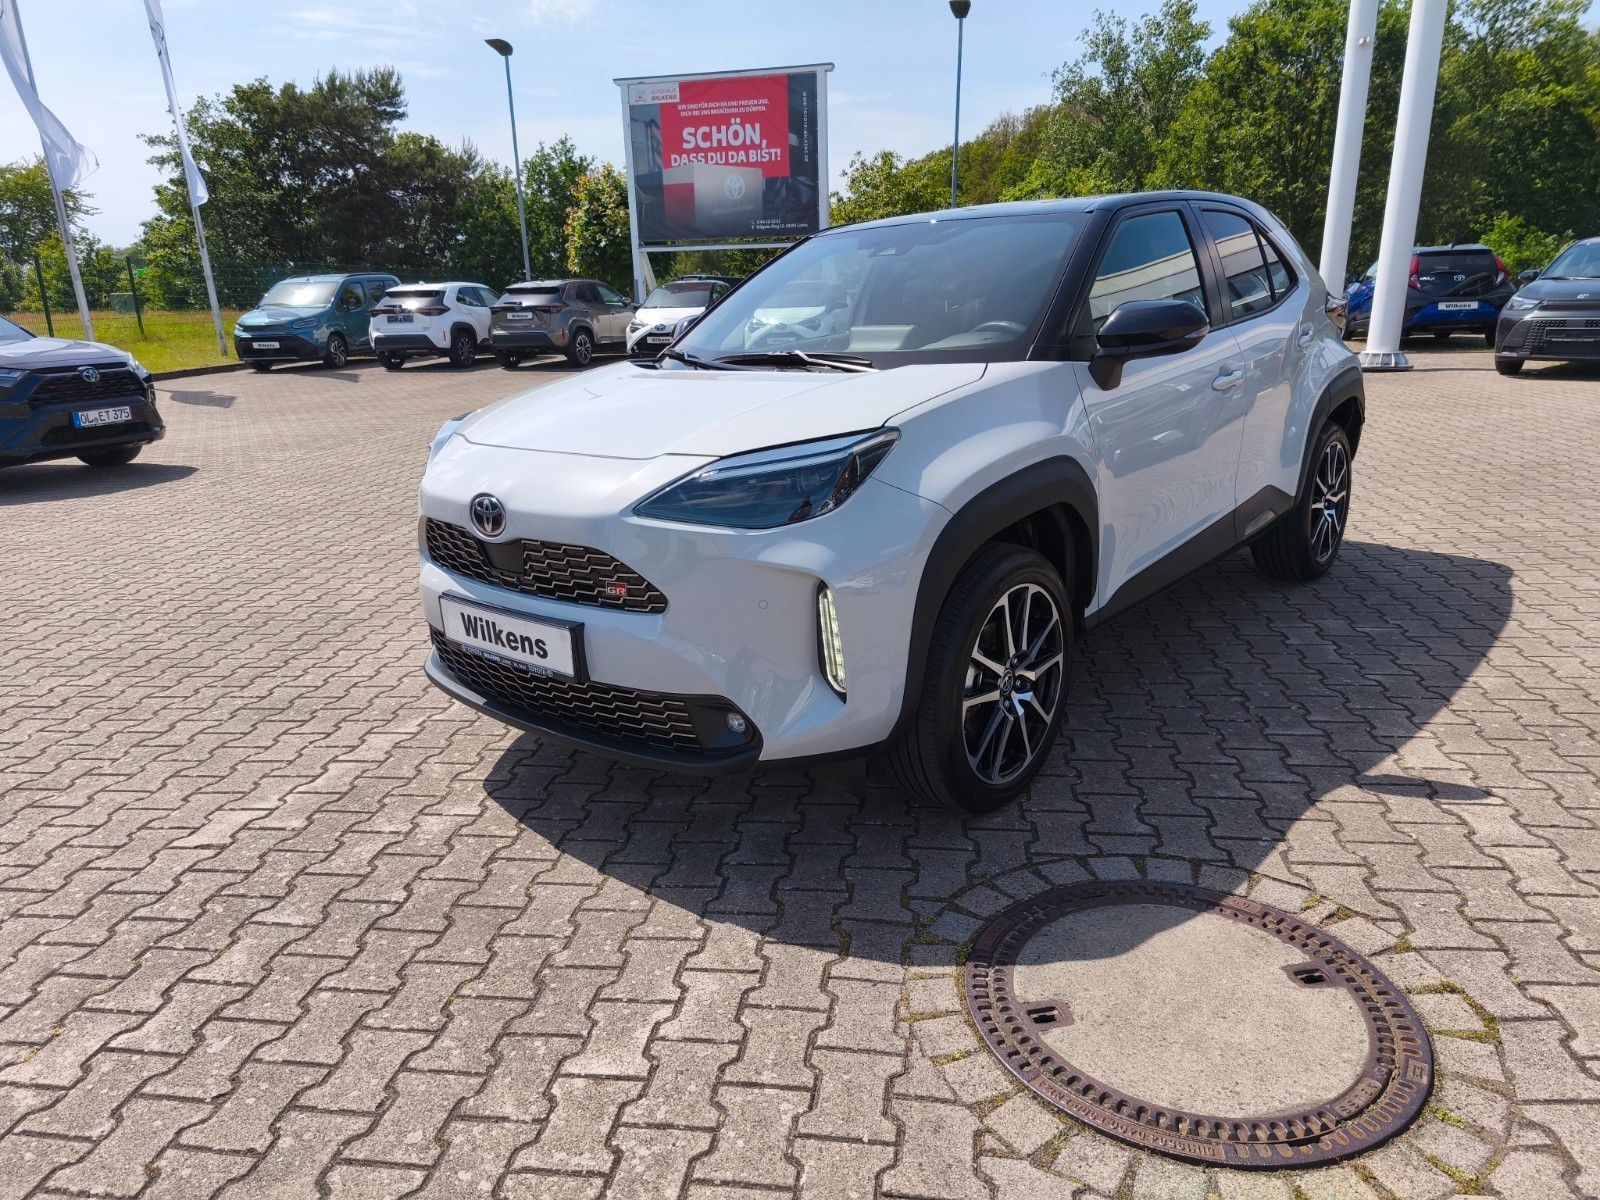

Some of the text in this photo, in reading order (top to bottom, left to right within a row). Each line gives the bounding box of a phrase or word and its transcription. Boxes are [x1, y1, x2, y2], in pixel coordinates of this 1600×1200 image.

[682, 117, 767, 149] SCHÖN,
[670, 148, 781, 166] DASS DU DA BIST!
[80, 408, 130, 424] OL ET 375
[608, 586, 625, 595] GR
[460, 612, 548, 659] Wilkens
